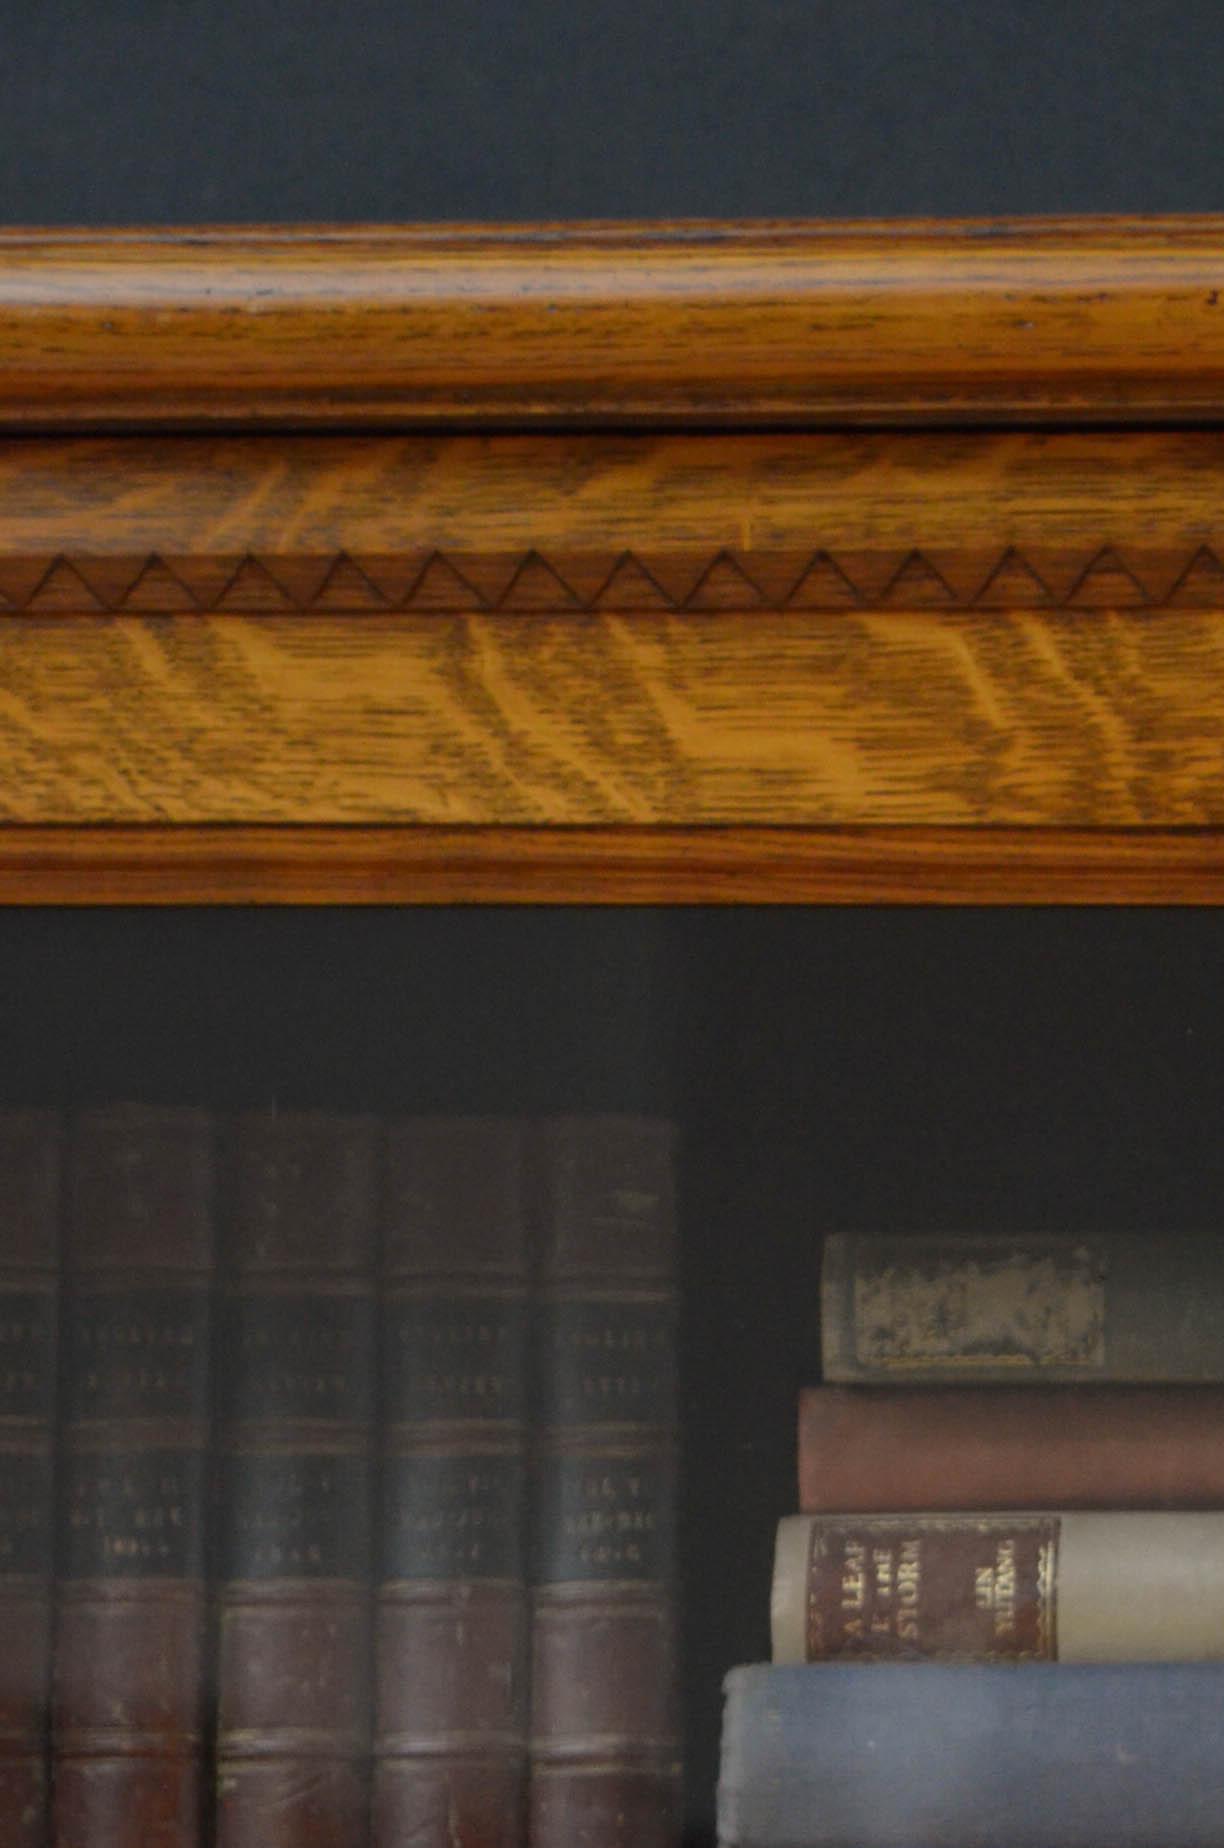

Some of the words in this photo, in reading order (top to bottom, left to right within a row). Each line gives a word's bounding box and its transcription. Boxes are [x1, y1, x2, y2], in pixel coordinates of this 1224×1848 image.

[841, 1539, 866, 1609] LEAF
[896, 1539, 923, 1640] STORM
[974, 1566, 993, 1609] LIN
[994, 1539, 1016, 1637] YUTANG
